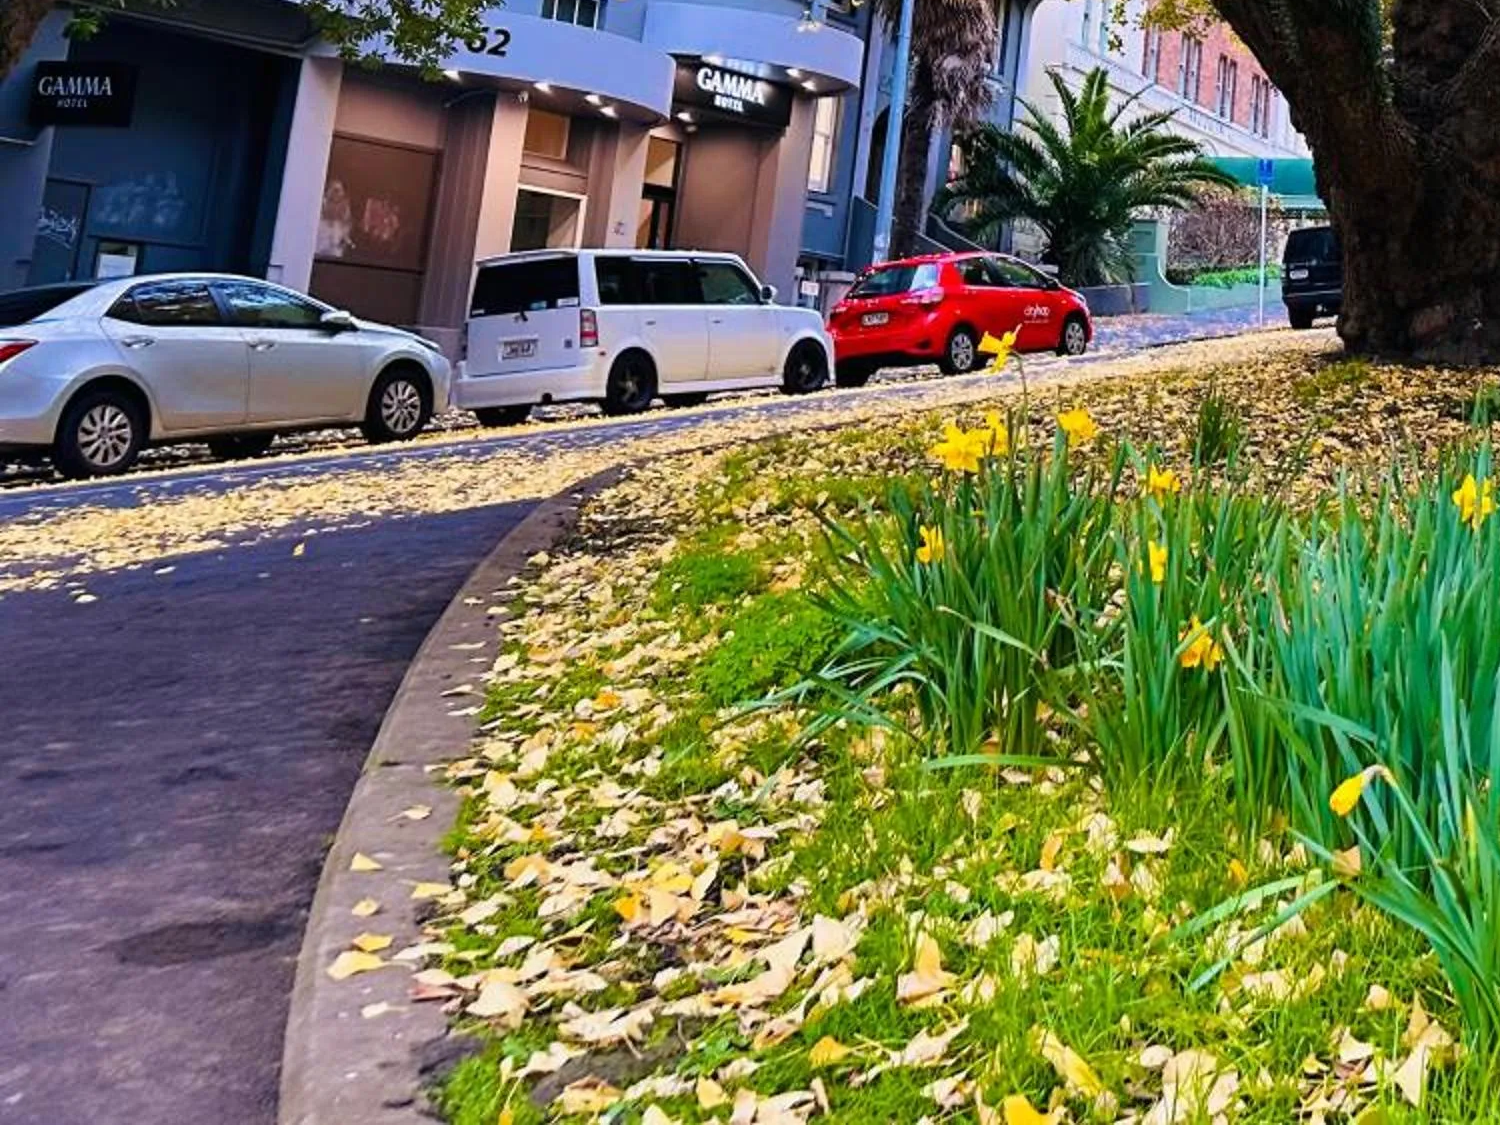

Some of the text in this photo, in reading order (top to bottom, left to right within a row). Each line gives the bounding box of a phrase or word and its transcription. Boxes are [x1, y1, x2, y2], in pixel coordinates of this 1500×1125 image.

[38, 76, 112, 96] GAMMA
[697, 67, 765, 106] GAMMA
[57, 99, 88, 108] HOTEL
